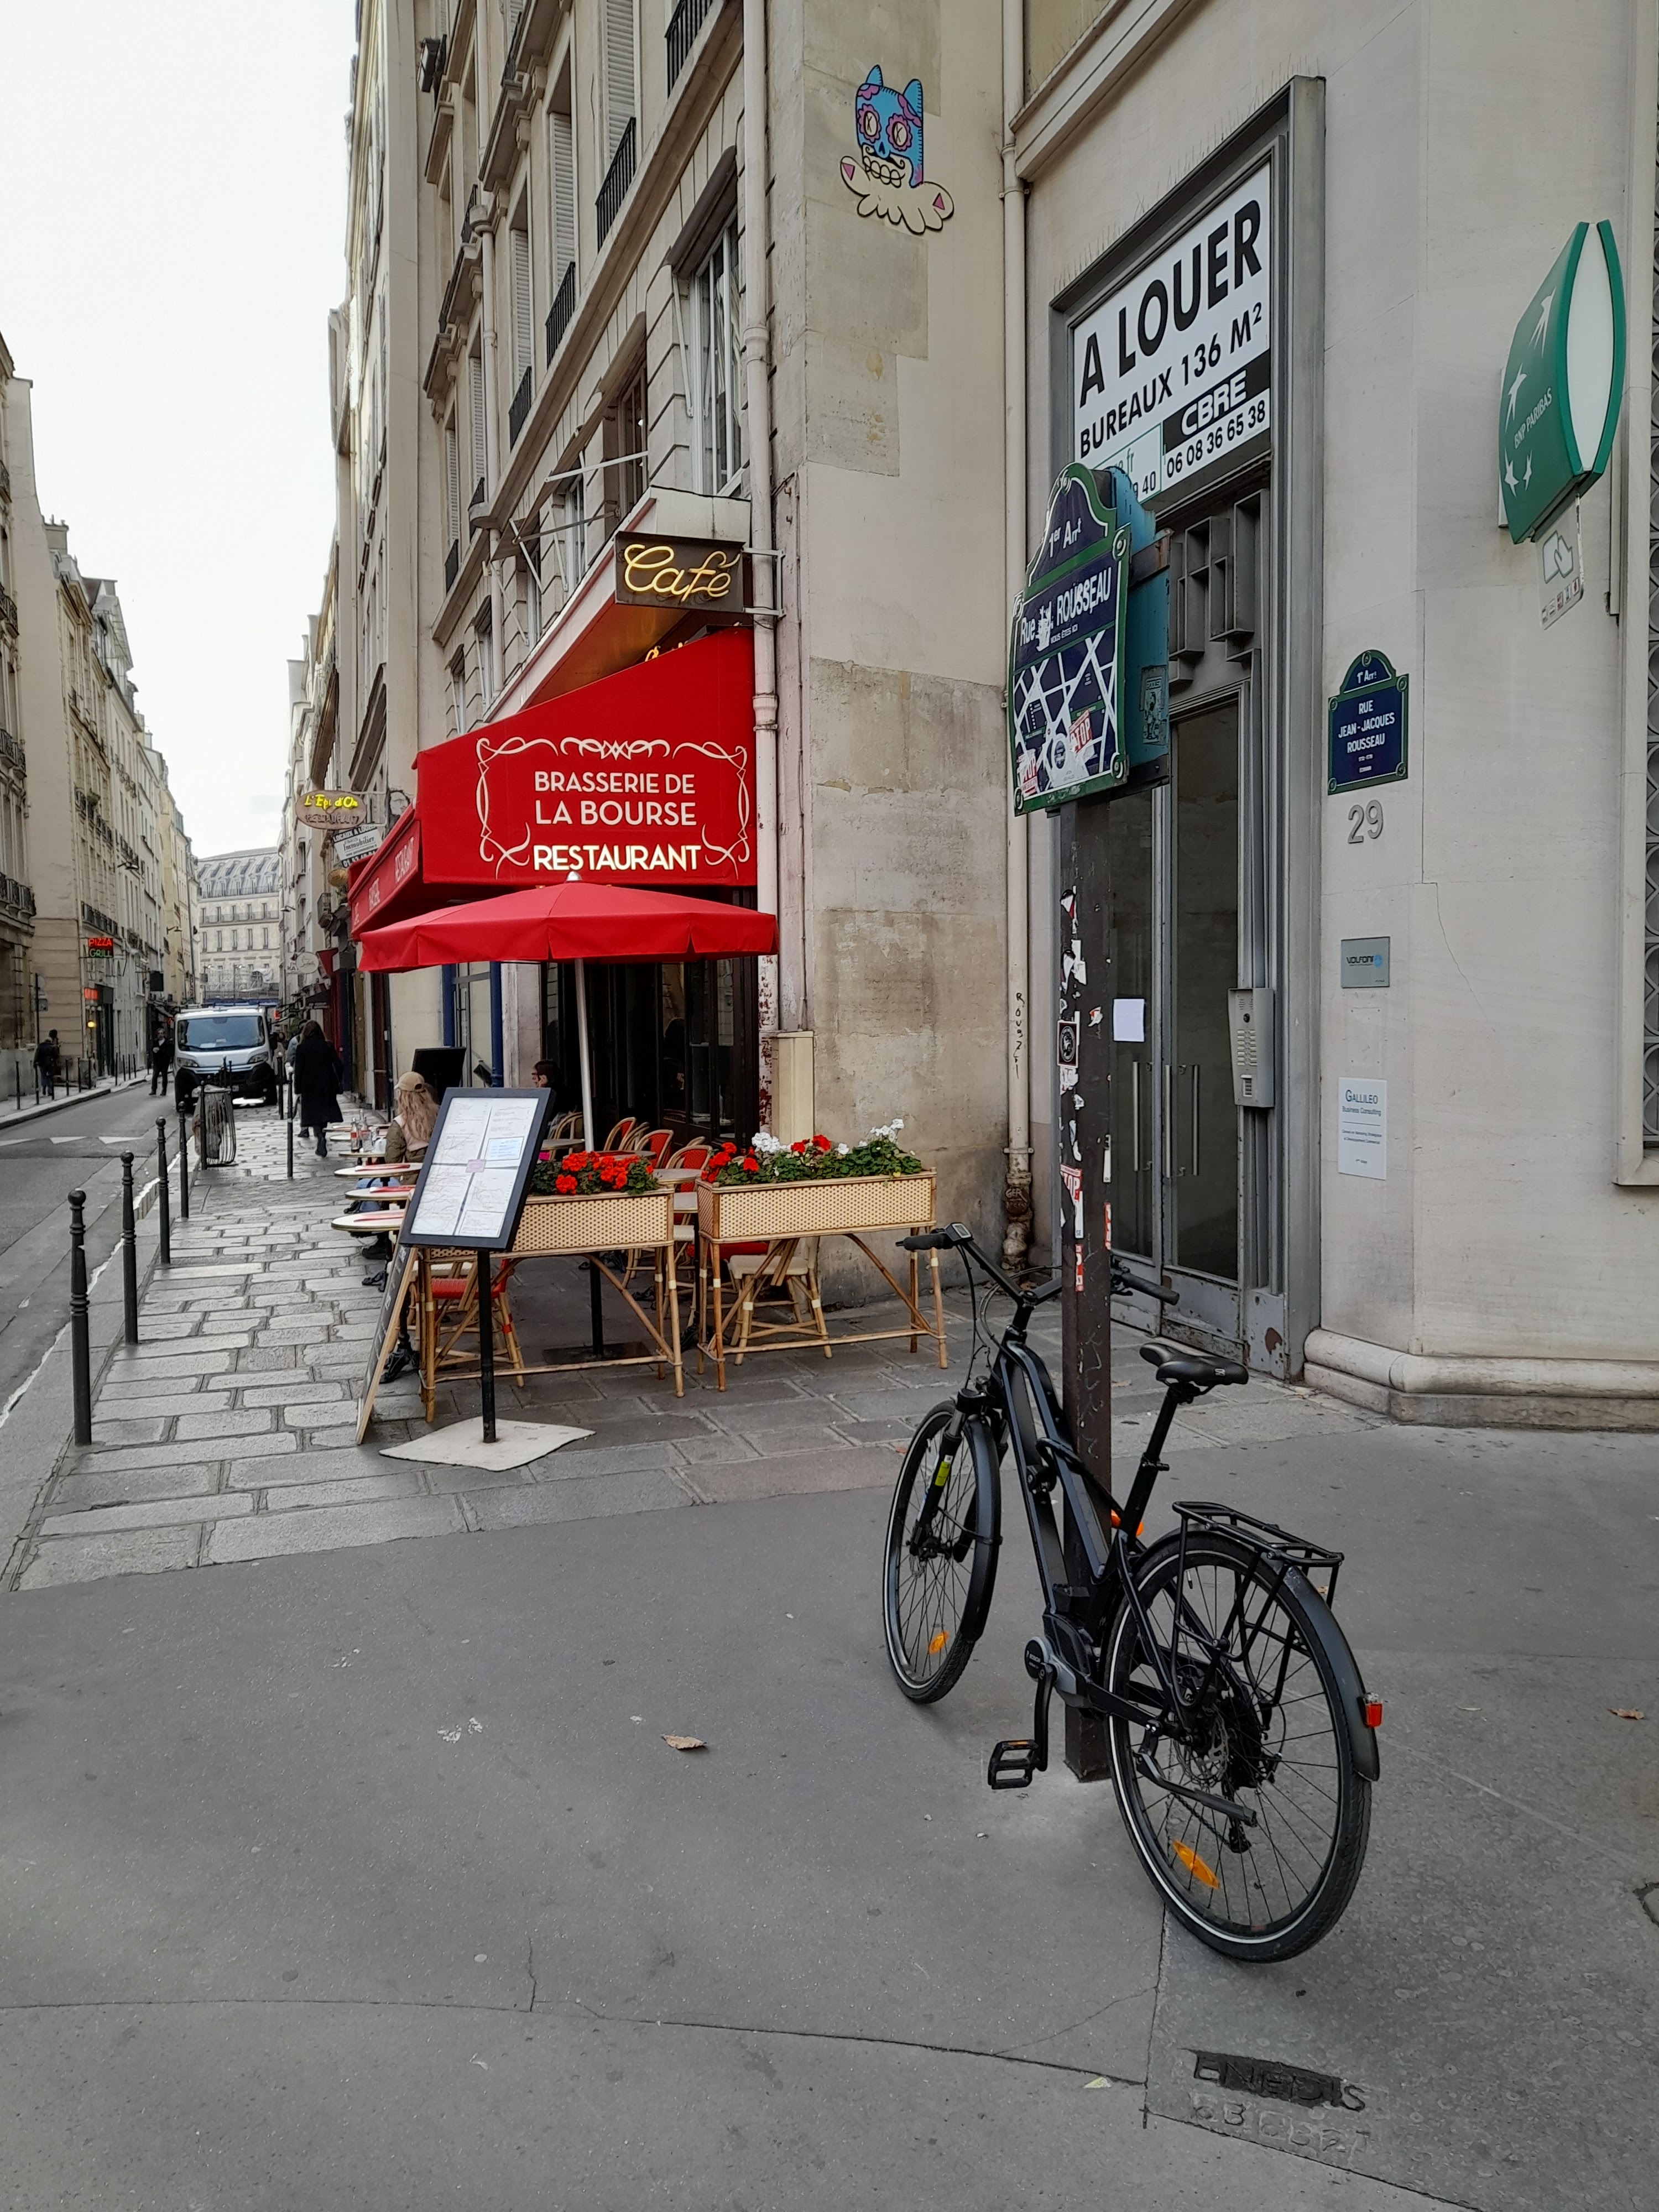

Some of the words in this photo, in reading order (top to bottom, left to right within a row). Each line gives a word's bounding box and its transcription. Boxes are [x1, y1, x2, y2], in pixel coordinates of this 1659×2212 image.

[1080, 332, 1105, 408] A
[1119, 200, 1262, 378] LOUER
[1081, 367, 1172, 459] BUREAUX
[1181, 333, 1221, 387] 136
[1181, 369, 1248, 436] CBRE
[1514, 422, 1526, 449] BNP
[1526, 387, 1552, 432] PARIBAS
[1166, 452, 1182, 478] 06
[1187, 439, 1203, 466] 08
[1207, 427, 1223, 455] 36
[1227, 413, 1244, 441] 65
[1248, 400, 1266, 429] 38
[1142, 471, 1156, 494] 40
[624, 544, 741, 602] Café
[1020, 617, 1035, 646] Rue
[1358, 700, 1374, 714] RUE
[1347, 733, 1385, 753] ROUSSEAU
[534, 771, 660, 793] BRASSERIE
[665, 774, 695, 794] DE
[535, 800, 572, 825] LA
[581, 800, 697, 826] BOURSE
[1348, 800, 1383, 844] 29
[332, 830, 354, 842] LOCAUX
[343, 836, 374, 851] Immobilier
[534, 844, 702, 871] RESTAURANT
[89, 938, 112, 947] PIZZA
[89, 948, 113, 958] GRILL
[1342, 1105, 1359, 1114] Business
[1360, 1107, 1382, 1117] Consulting
